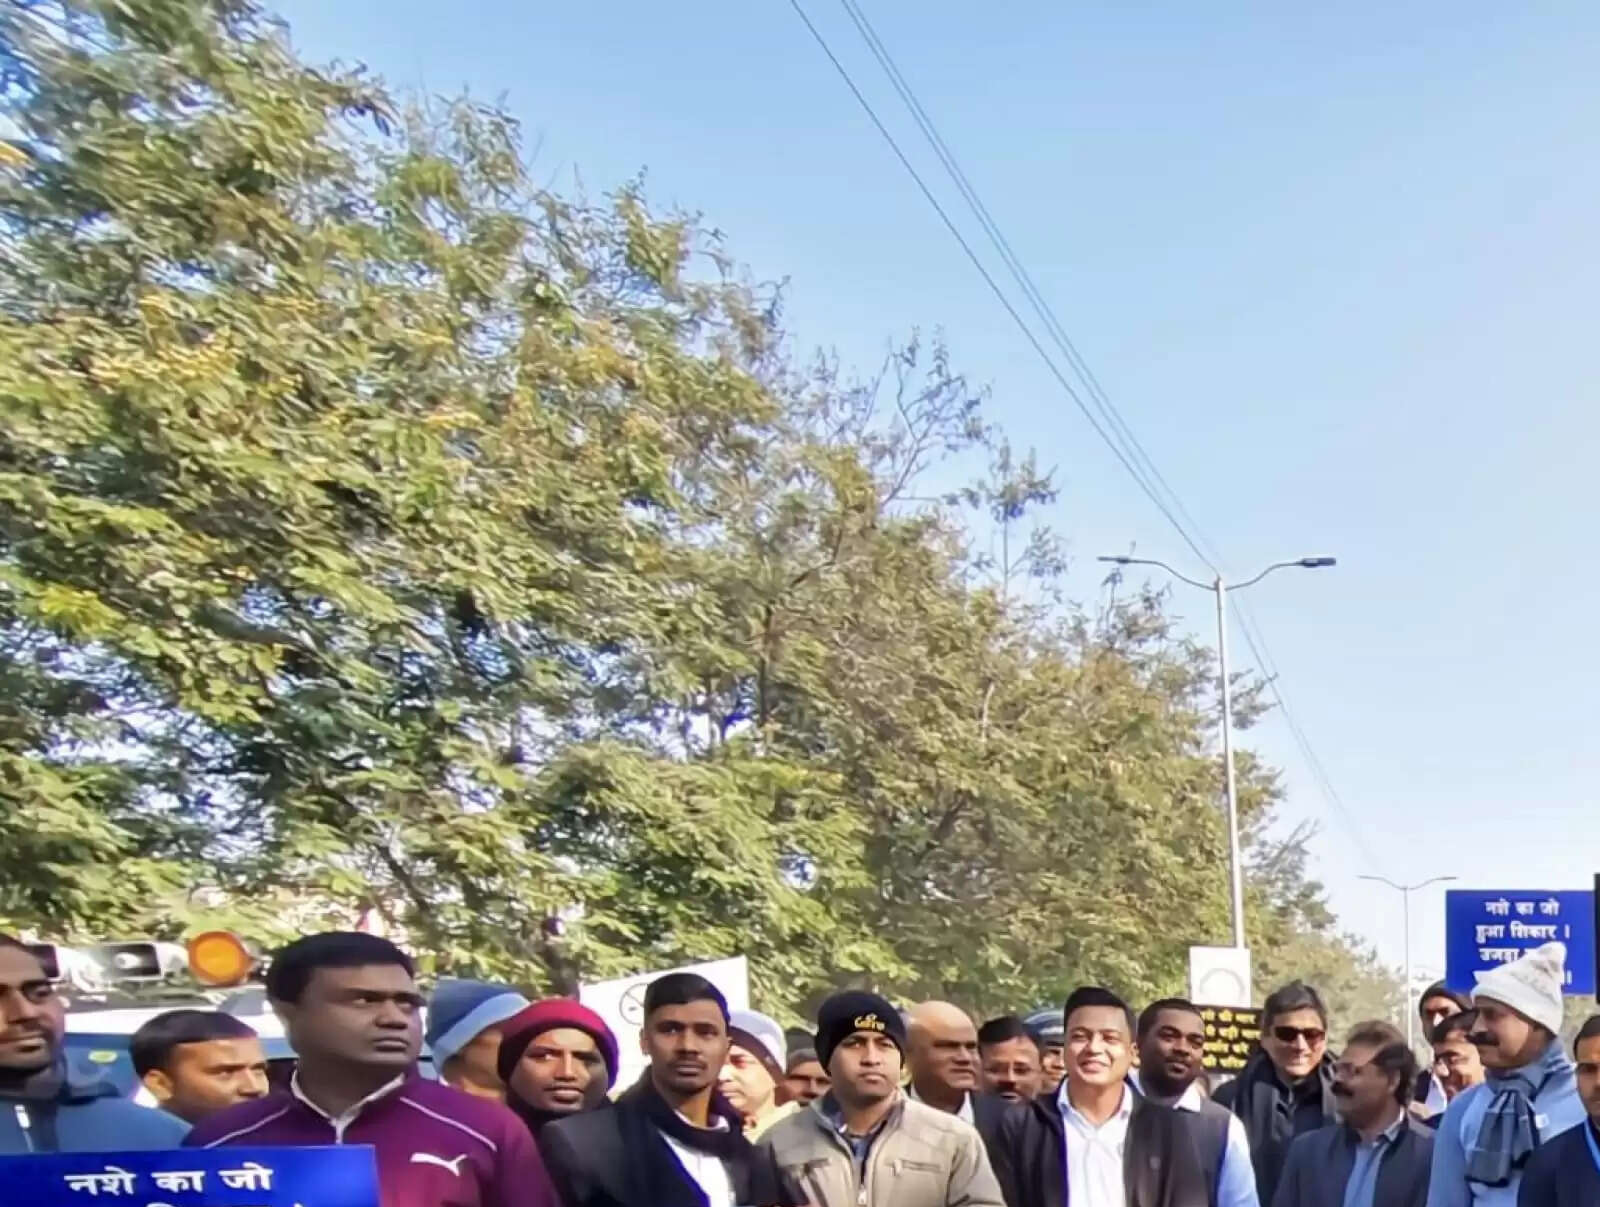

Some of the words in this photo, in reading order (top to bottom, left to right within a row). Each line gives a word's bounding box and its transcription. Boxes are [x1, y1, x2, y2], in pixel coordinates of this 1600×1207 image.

[64, 1166, 137, 1196] नशे
[152, 1171, 205, 1193] का
[218, 1162, 274, 1191] जो
